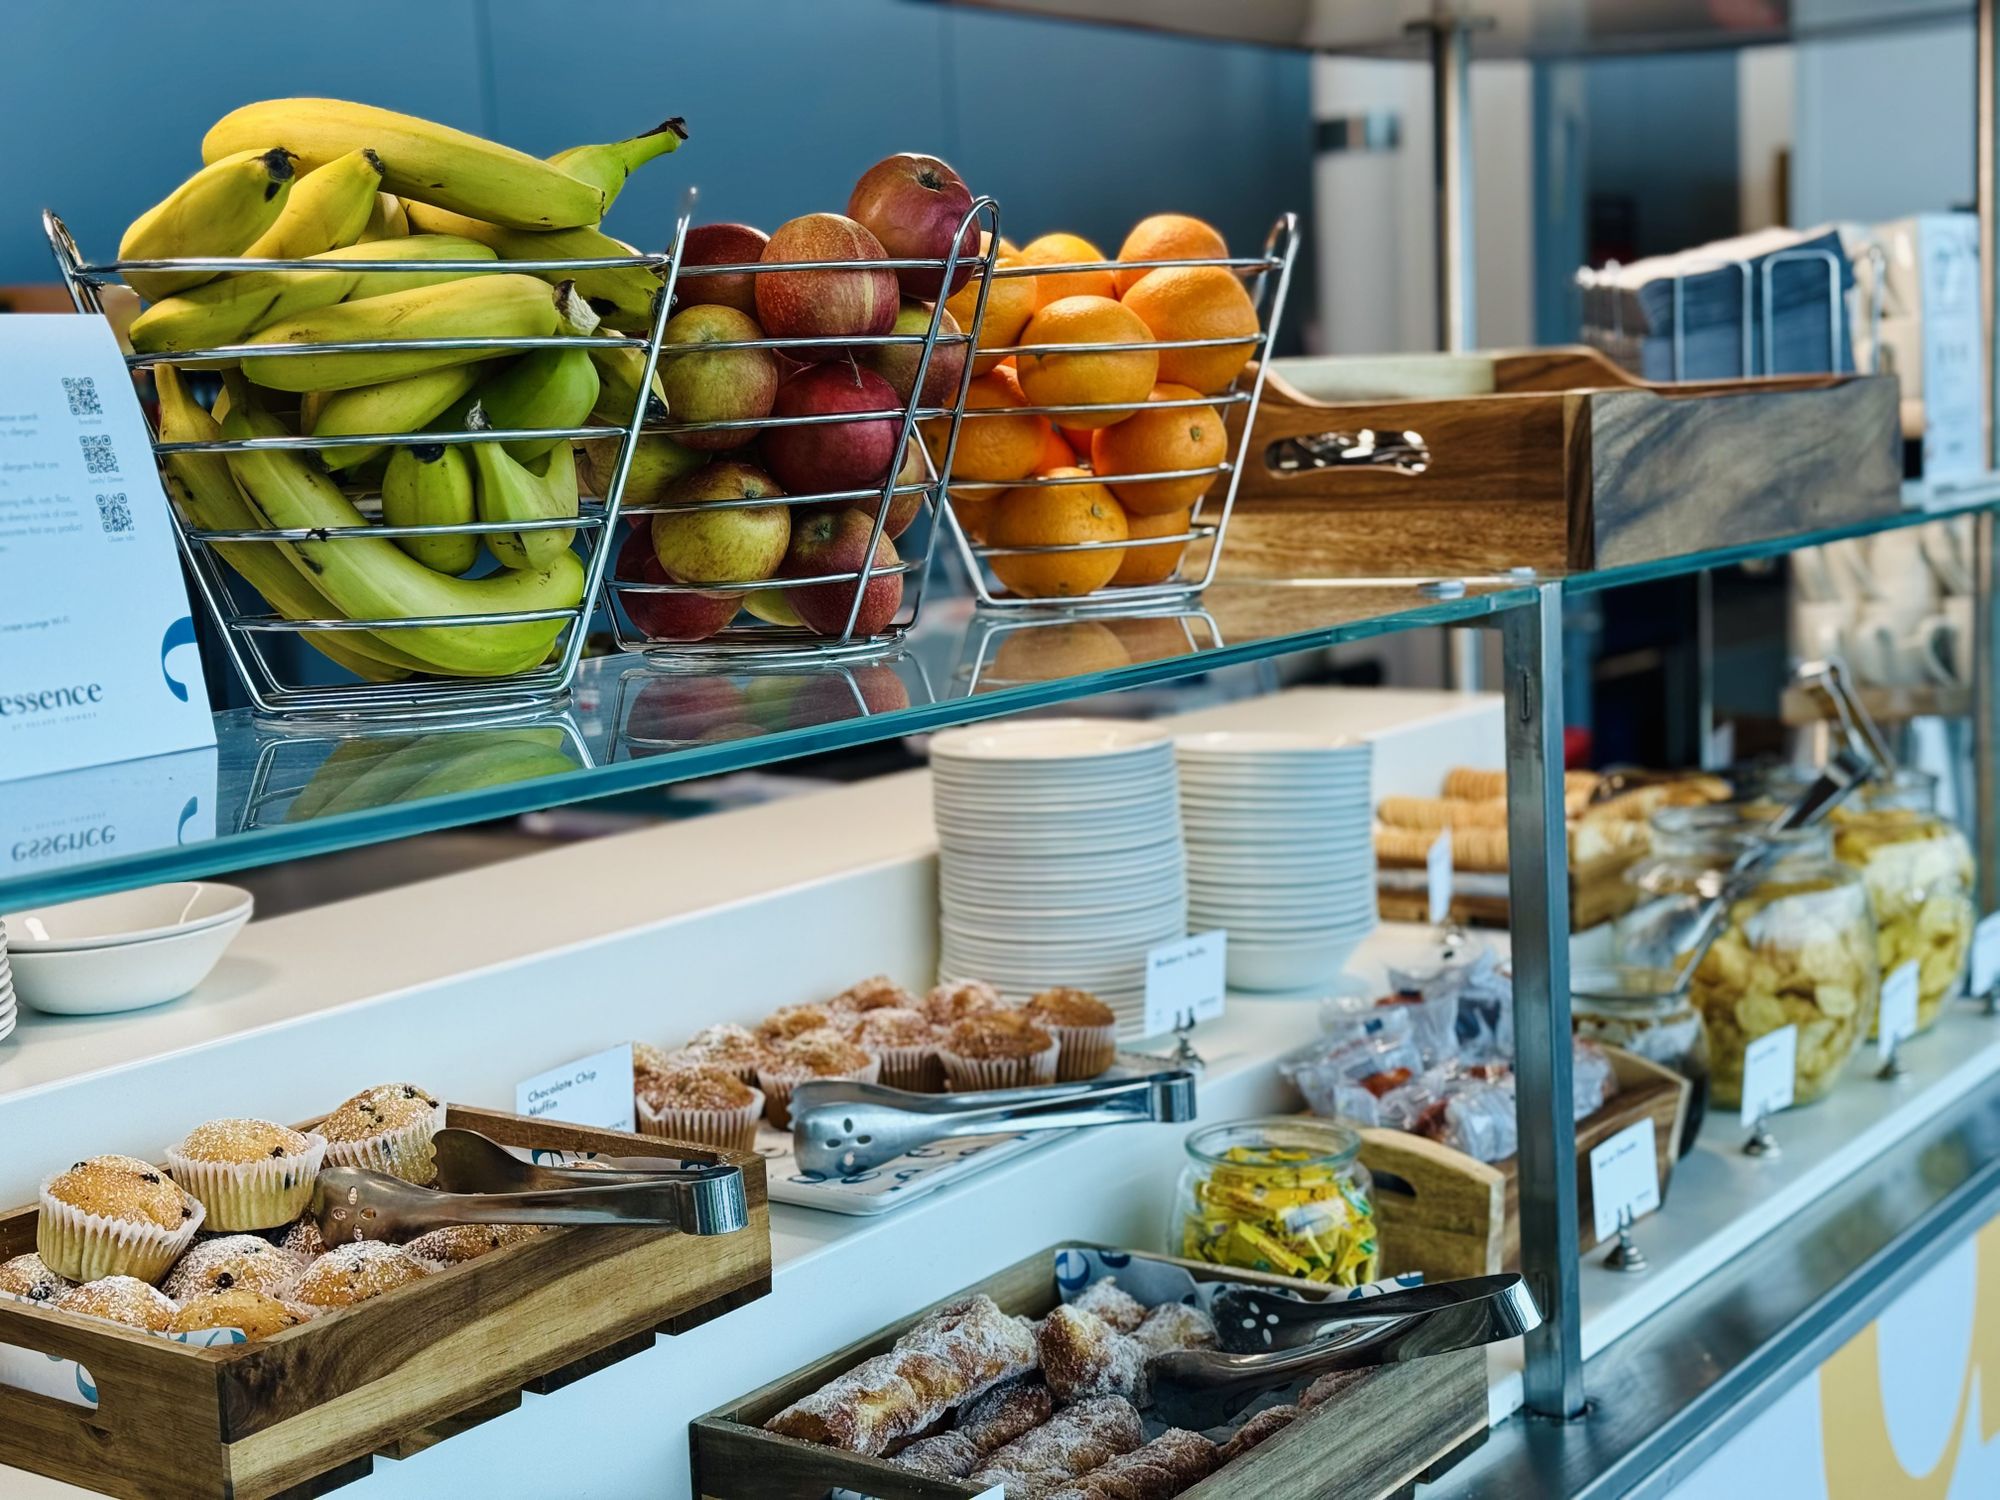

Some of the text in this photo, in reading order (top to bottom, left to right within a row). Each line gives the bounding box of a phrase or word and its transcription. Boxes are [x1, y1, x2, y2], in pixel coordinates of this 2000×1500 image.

[0, 683, 103, 716] essence
[528, 1070, 597, 1103] Chocolate Chip
[528, 1099, 558, 1116] Muffin
